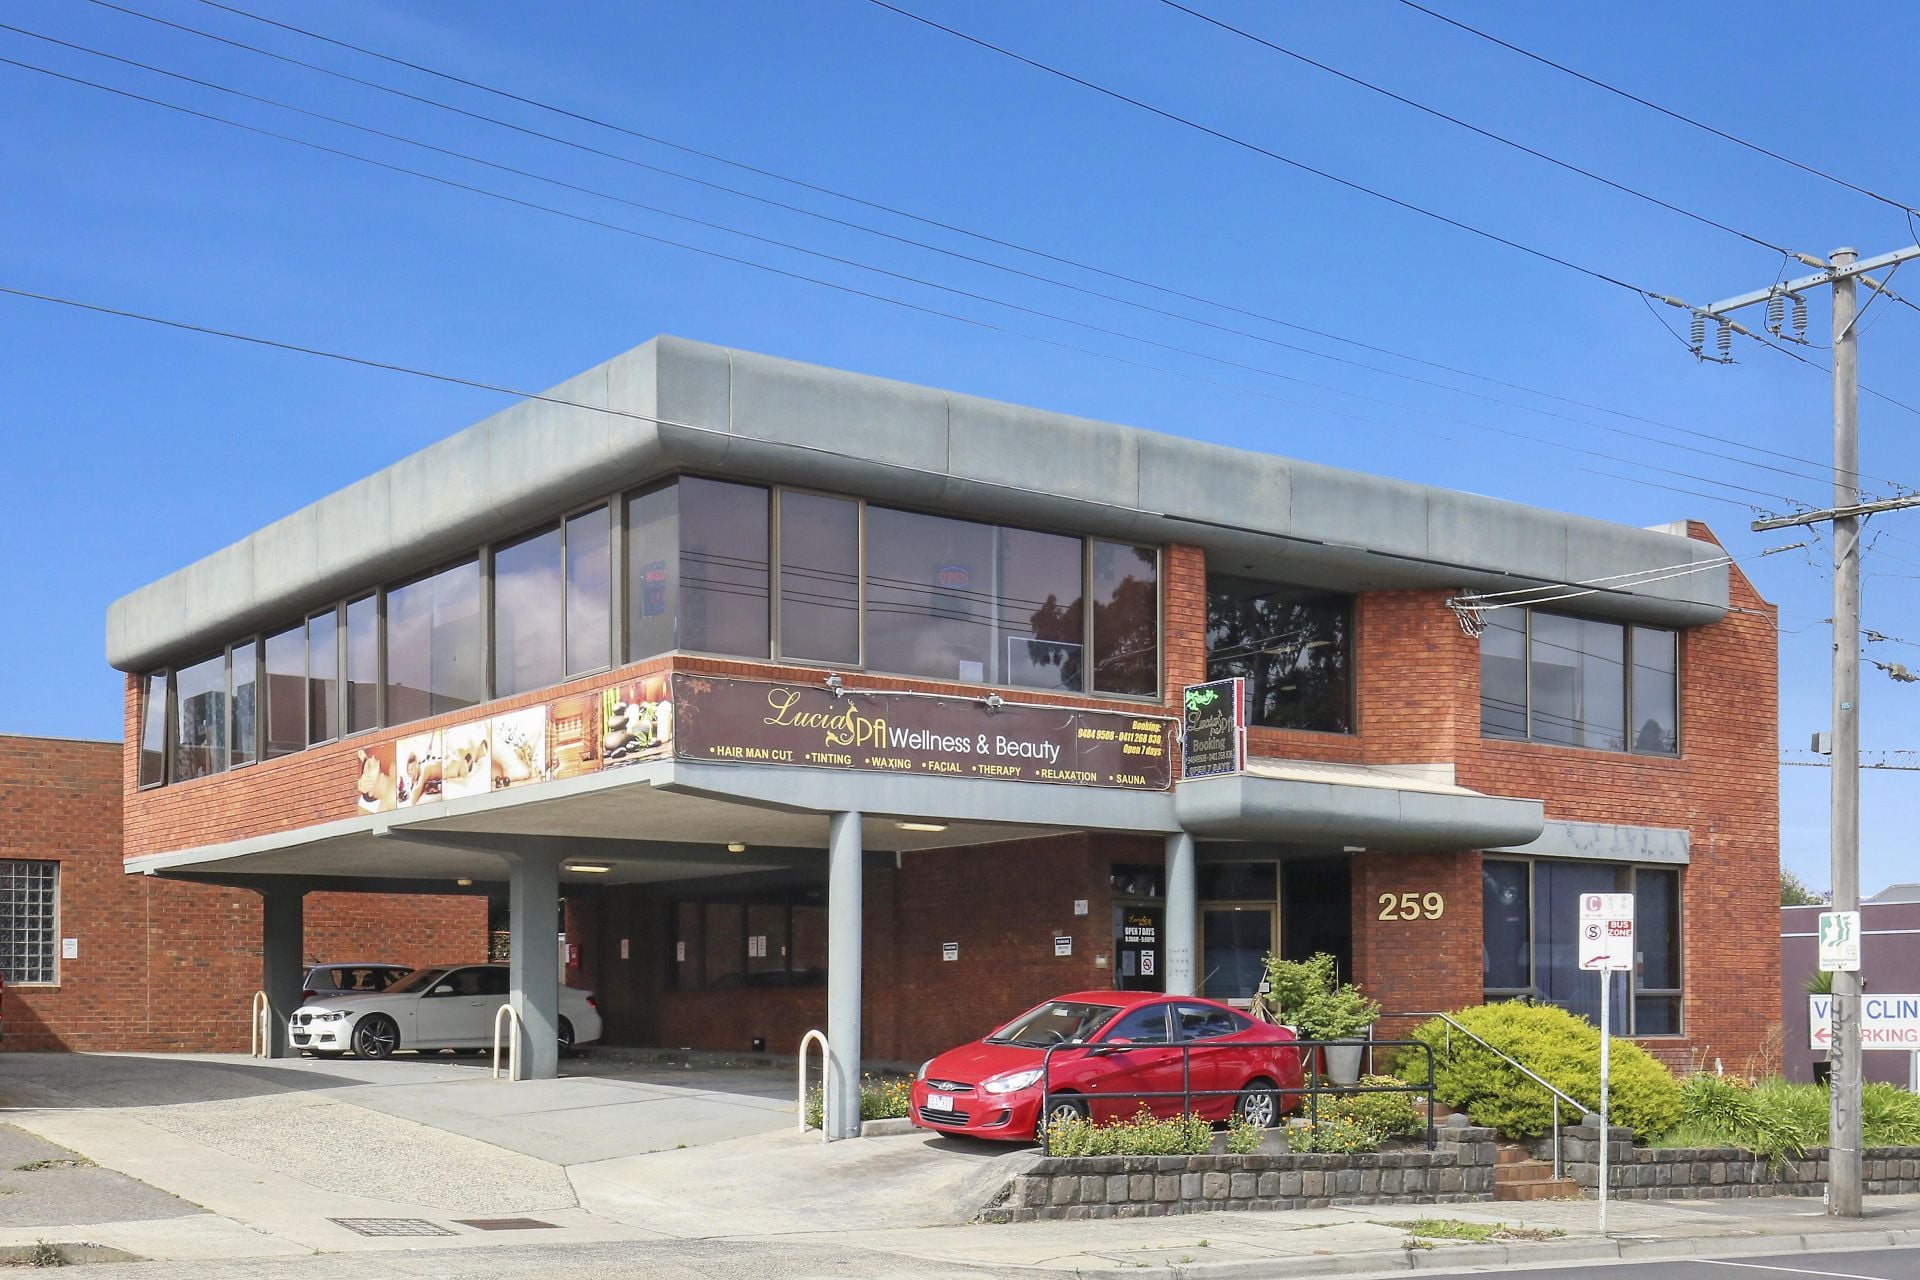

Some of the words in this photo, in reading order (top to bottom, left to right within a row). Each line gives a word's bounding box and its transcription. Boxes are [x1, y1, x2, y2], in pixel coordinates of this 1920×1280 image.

[764, 688, 846, 730] Lucia
[889, 726, 971, 753] Wellness
[976, 734, 990, 755] &
[996, 735, 1060, 764] Beauty
[1132, 720, 1162, 732] Booking:
[1123, 744, 1140, 755] Open
[1141, 745, 1146, 754] 7
[1146, 746, 1162, 757] days
[1193, 736, 1226, 752] Booking
[717, 746, 743, 758] HAIR
[745, 748, 769, 760] MAN
[771, 749, 794, 761] CUT
[811, 752, 852, 765] TINTING
[872, 756, 912, 769] WAXING
[928, 760, 963, 773] FACIAL
[978, 764, 1021, 777] THERAPY
[1041, 769, 1097, 782] RELAXATION
[1116, 774, 1146, 785] SAUNA
[1378, 892, 1444, 921] 259
[1125, 927, 1138, 936] OPEN
[1138, 927, 1142, 936] 7
[1866, 1000, 1918, 1019] CLIN
